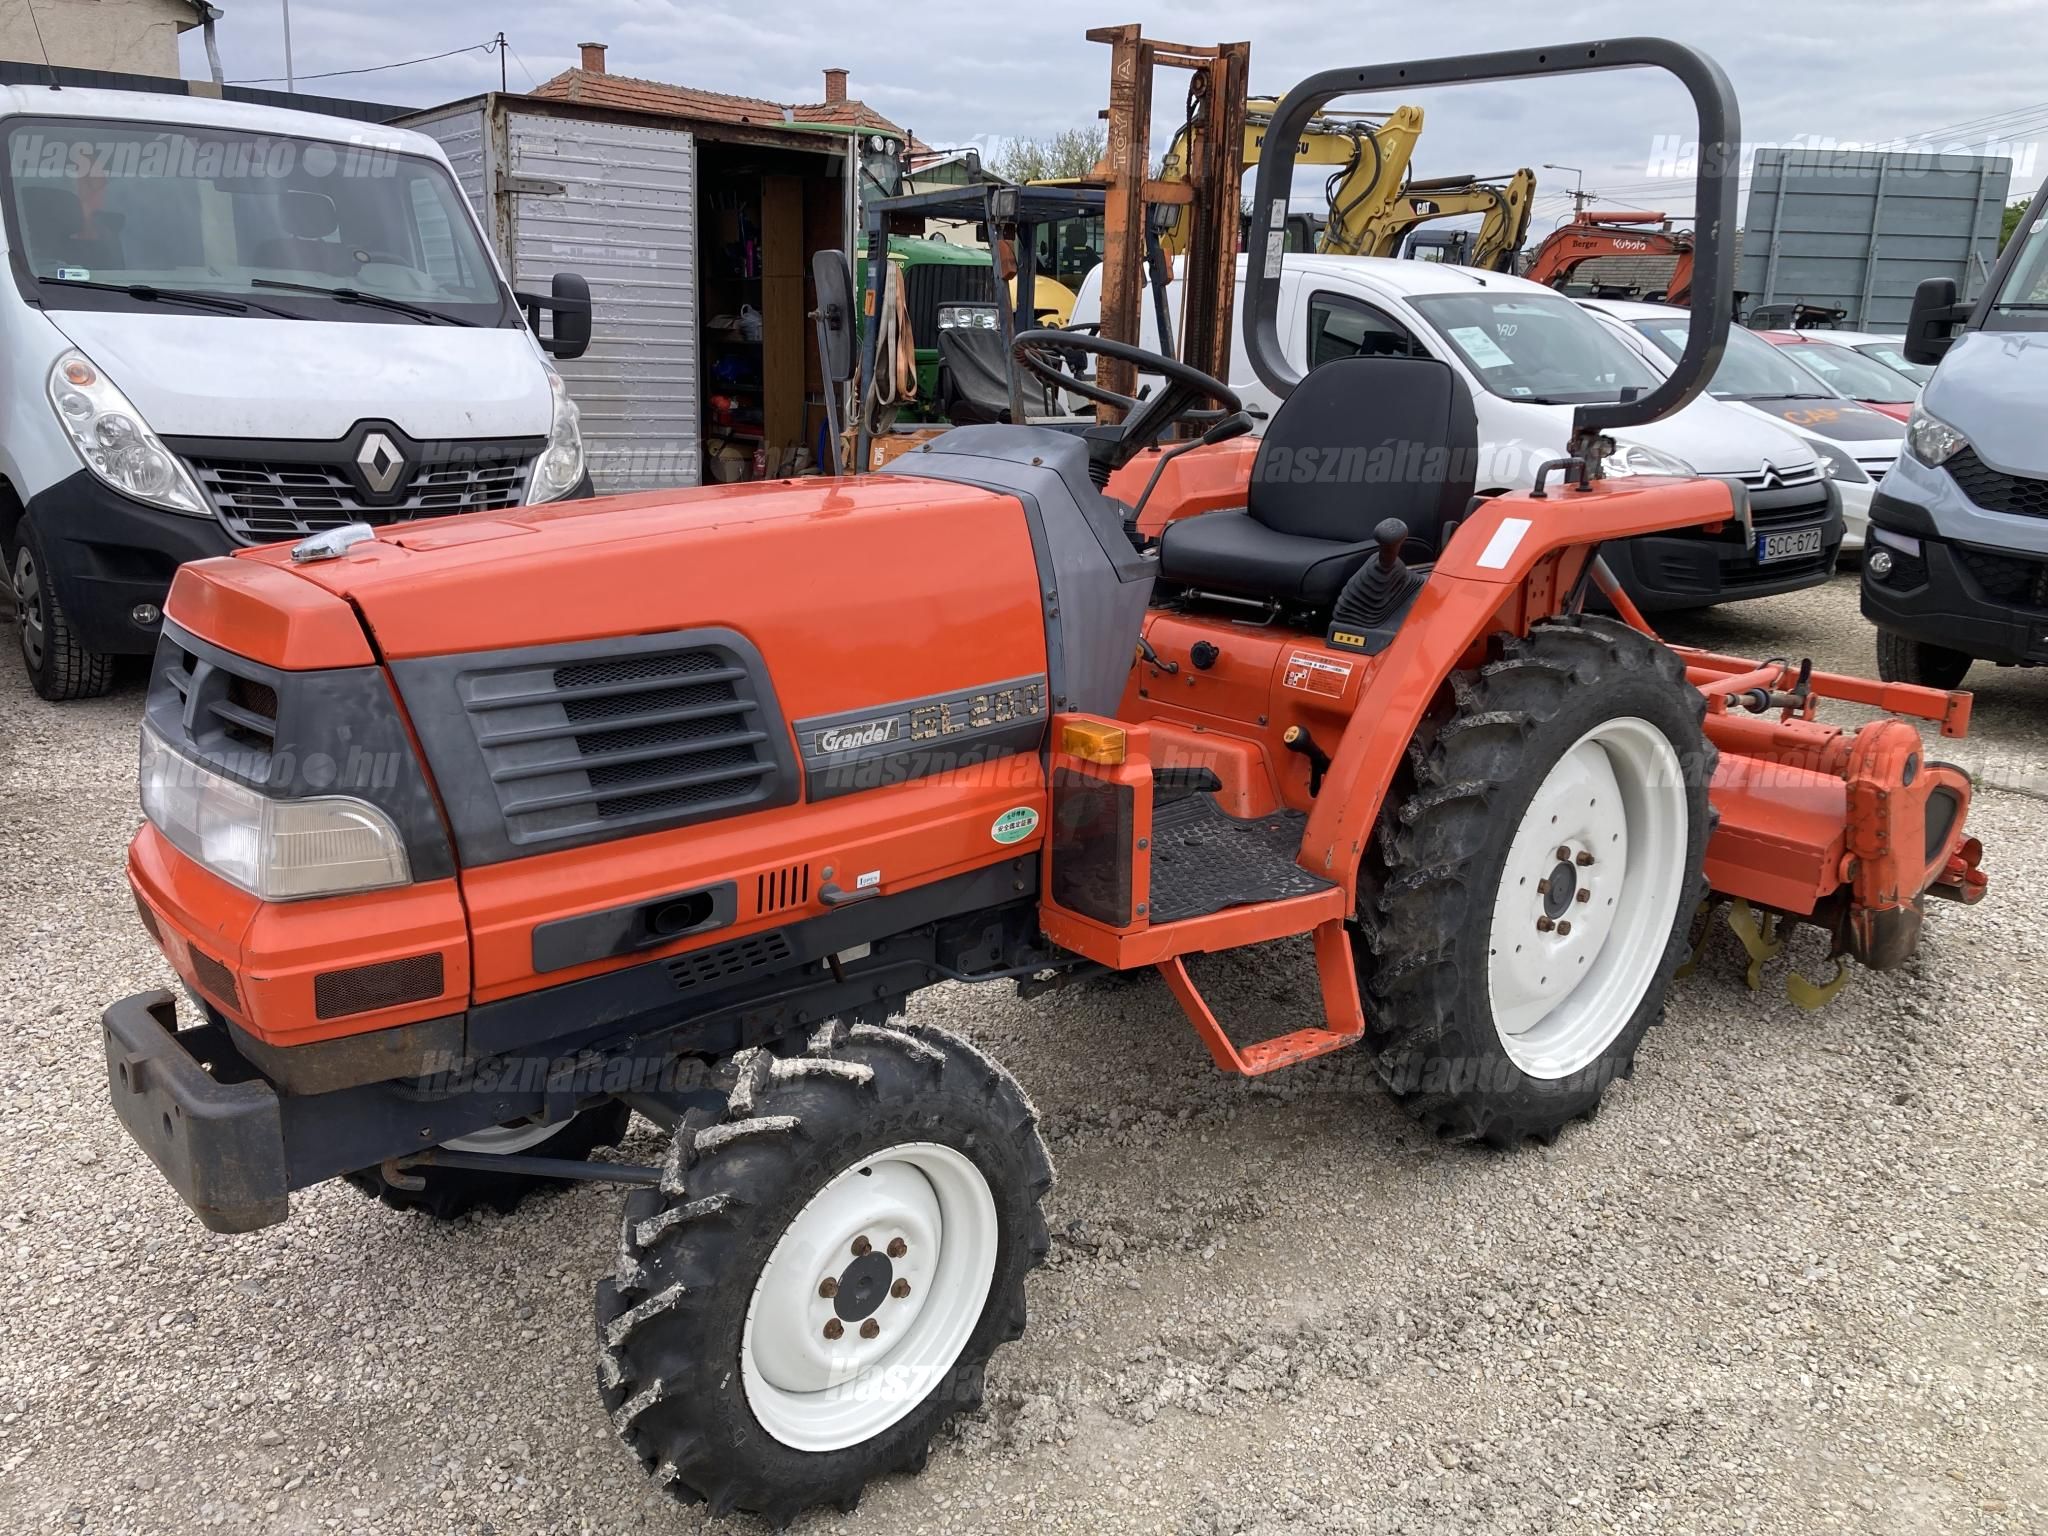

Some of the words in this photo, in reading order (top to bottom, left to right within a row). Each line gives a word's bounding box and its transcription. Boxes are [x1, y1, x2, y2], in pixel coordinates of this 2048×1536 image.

[1416, 201, 1431, 215] CAT
[1571, 240, 1598, 249] Berger
[1612, 238, 1647, 250] Kubota
[1768, 532, 1819, 556] SCC-672
[822, 720, 891, 751] Grandel
